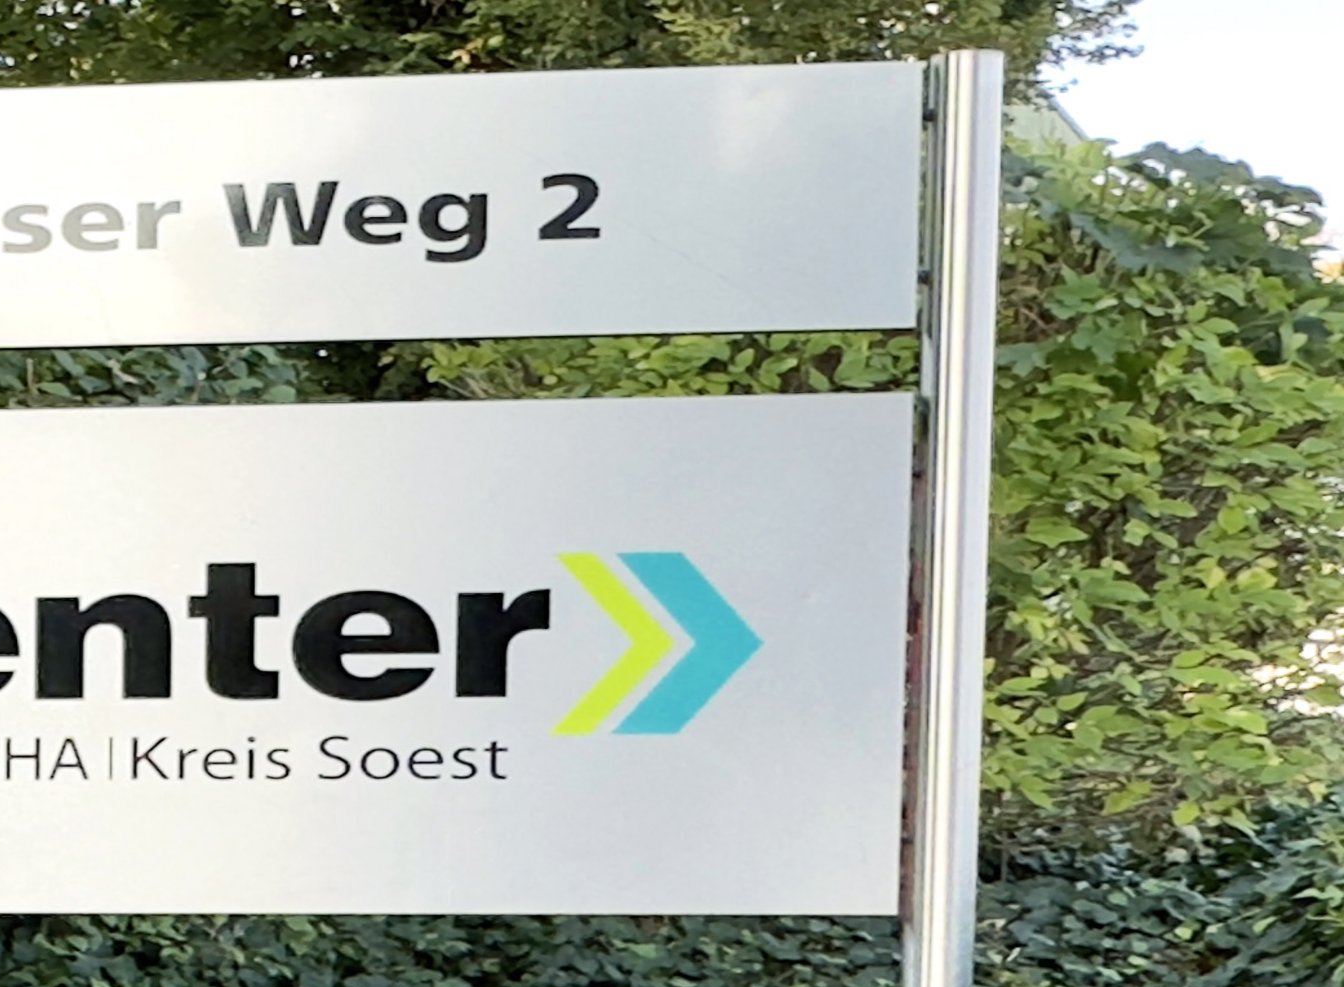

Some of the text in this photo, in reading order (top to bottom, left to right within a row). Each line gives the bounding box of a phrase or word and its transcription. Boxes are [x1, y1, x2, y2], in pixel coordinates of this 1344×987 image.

[224, 180, 489, 263] Weg
[538, 173, 602, 240] 2
[317, 734, 510, 781] Soest
